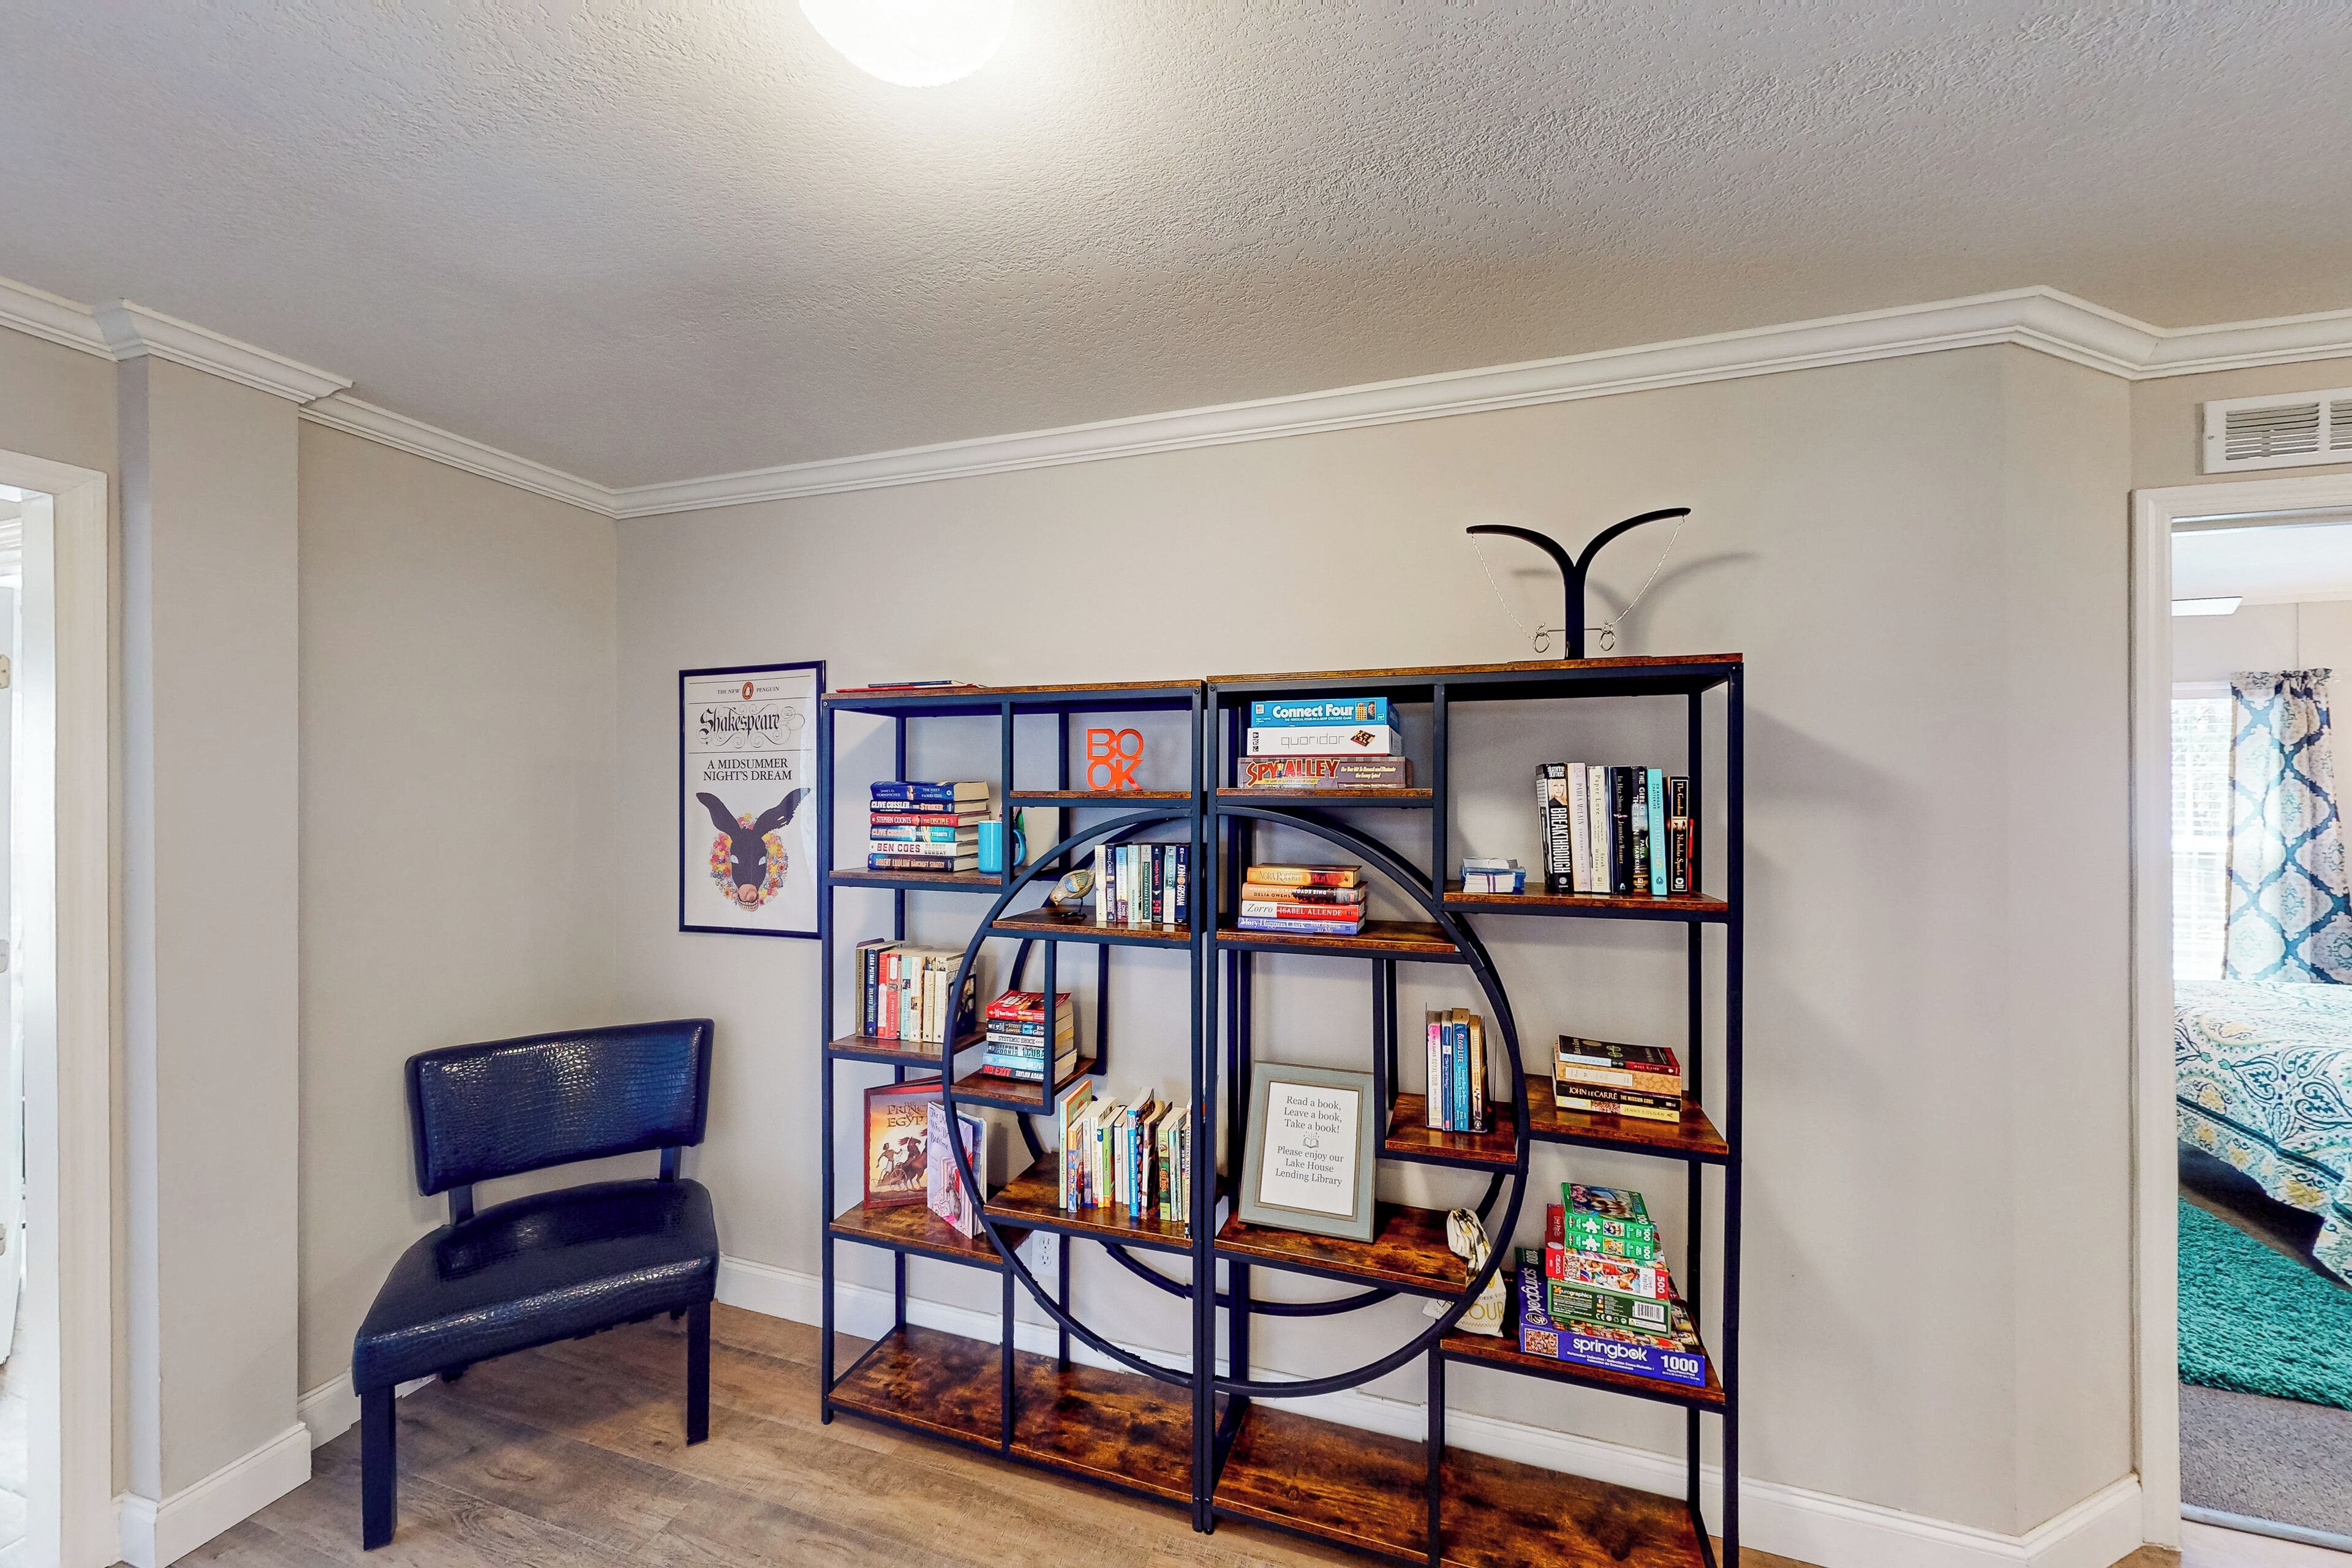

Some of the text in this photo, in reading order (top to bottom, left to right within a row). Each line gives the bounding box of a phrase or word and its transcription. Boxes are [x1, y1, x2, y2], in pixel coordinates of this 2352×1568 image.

[1272, 705, 1323, 718] Connect
[1325, 704, 1354, 716] Four
[698, 706, 780, 737] Shakespeare
[1281, 733, 1344, 748] quoridor
[707, 758, 788, 769] A MIDSUMMER
[703, 770, 792, 782] NIGHT'S DREAM
[1245, 761, 1277, 788] SPY
[1639, 807, 1645, 816] ON
[897, 843, 920, 852] COES
[1550, 807, 1570, 873] BREAKTHROUGH
[892, 858, 910, 867] LUDLUM
[1675, 858, 1683, 875] Sparks
[1259, 871, 1301, 883] NORA ROBERTS
[1177, 864, 1186, 906] JOHN GRISHAM
[1247, 903, 1273, 913] Zorro
[1240, 918, 1259, 928] Mary
[1260, 919, 1285, 929] Higgins
[995, 1067, 1011, 1076] EXIT
[1569, 1087, 1587, 1095] JOHN
[887, 1105, 927, 1115] PRINC
[1286, 1096, 1308, 1106] Read
[1317, 1098, 1342, 1111] book,
[1284, 1107, 1309, 1118] Leave
[1318, 1110, 1343, 1123] book,
[1284, 1118, 1305, 1129] Take
[1315, 1121, 1340, 1134] book!
[930, 1132, 948, 1150] Bedtime
[1277, 1146, 1303, 1157] Please
[1305, 1150, 1327, 1162] enjoy
[1286, 1158, 1334, 1172] Lake House
[1275, 1168, 1343, 1187] Lending Library
[1637, 1214, 1648, 1225] 100
[1526, 1250, 1538, 1265] 1000
[1521, 1268, 1545, 1314] springbok
[1657, 1276, 1665, 1294] 500
[1573, 1338, 1648, 1362] springbok
[1660, 1355, 1698, 1373] 1000
